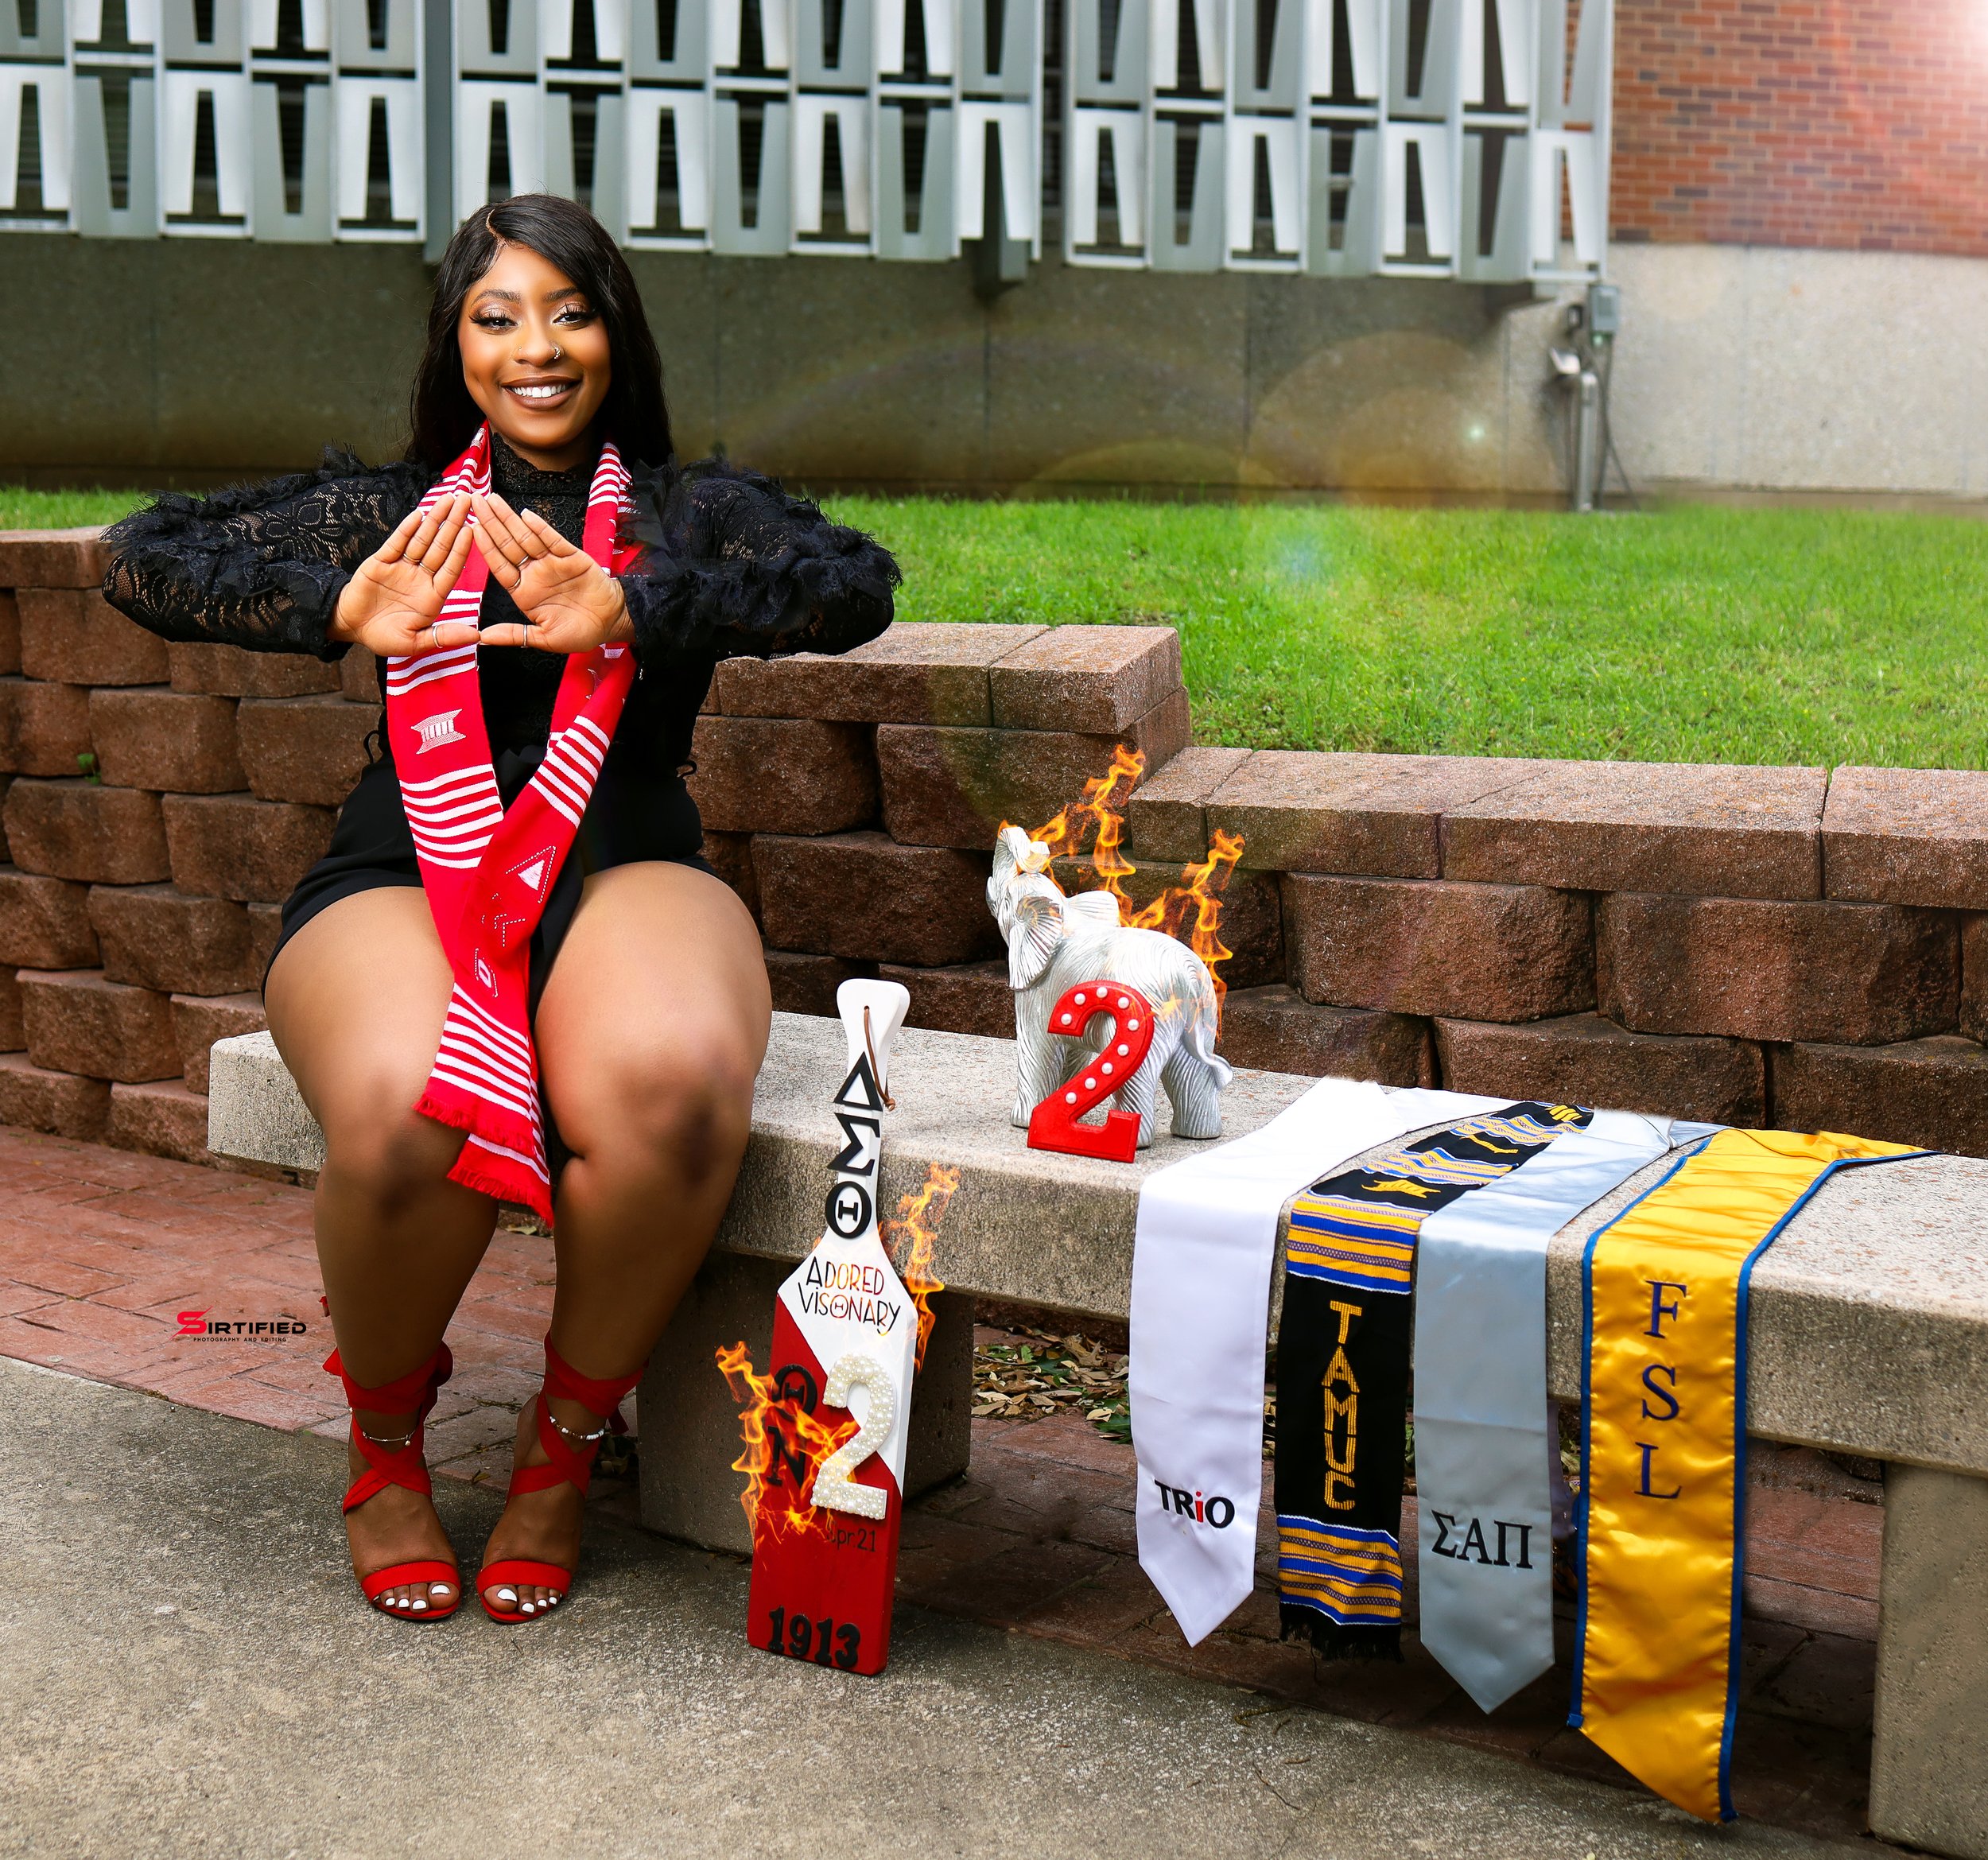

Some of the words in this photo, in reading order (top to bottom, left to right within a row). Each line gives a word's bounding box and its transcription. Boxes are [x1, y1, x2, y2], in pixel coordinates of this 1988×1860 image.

[1027, 980, 1155, 1163] 2
[806, 1256, 884, 1295] ADORED
[810, 1353, 895, 1520] 2
[1321, 1300, 1362, 1510] TAMUC
[1154, 1479, 1235, 1529] TRiO
[768, 1606, 860, 1668] 1913
